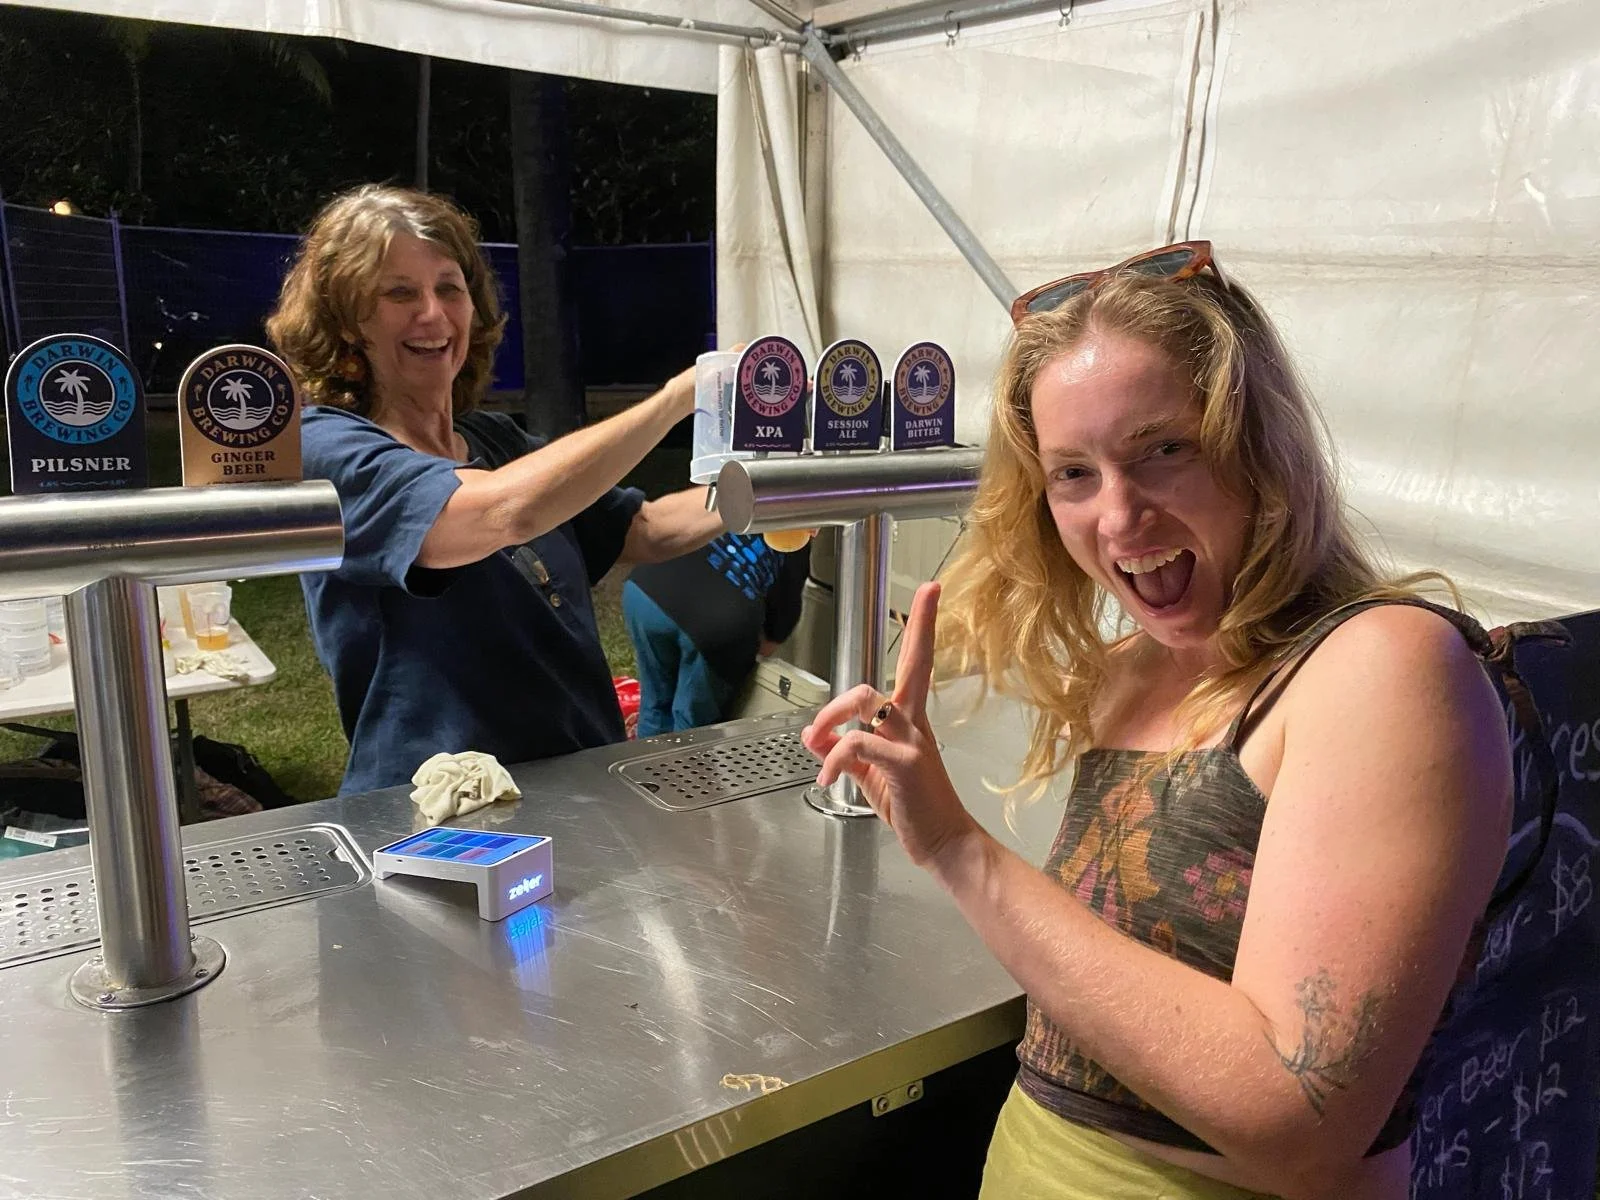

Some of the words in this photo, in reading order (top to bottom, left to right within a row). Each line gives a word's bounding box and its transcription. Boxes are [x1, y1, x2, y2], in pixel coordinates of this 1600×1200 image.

[32, 342, 119, 370] DARWIN
[750, 343, 797, 364] DARWIN
[829, 346, 872, 364] DARWIN
[904, 348, 946, 367] DARWIN
[200, 354, 278, 381] DARWIN
[743, 383, 788, 415] BREWING
[822, 385, 865, 415] BREWING
[899, 388, 940, 414] BREWING
[22, 399, 111, 442] BREWING
[193, 406, 271, 445] BREWING
[827, 420, 869, 429] SESSION
[905, 418, 943, 430] DARWIN
[755, 425, 783, 438] XPA
[839, 430, 857, 438] ALE
[908, 428, 941, 438] BITTER
[31, 457, 131, 473] PILSNER
[211, 451, 276, 464] GINGER
[223, 464, 266, 475] BEER
[1547, 849, 1592, 937] $8
[1539, 995, 1587, 1063] $12
[1510, 1062, 1568, 1142] $12
